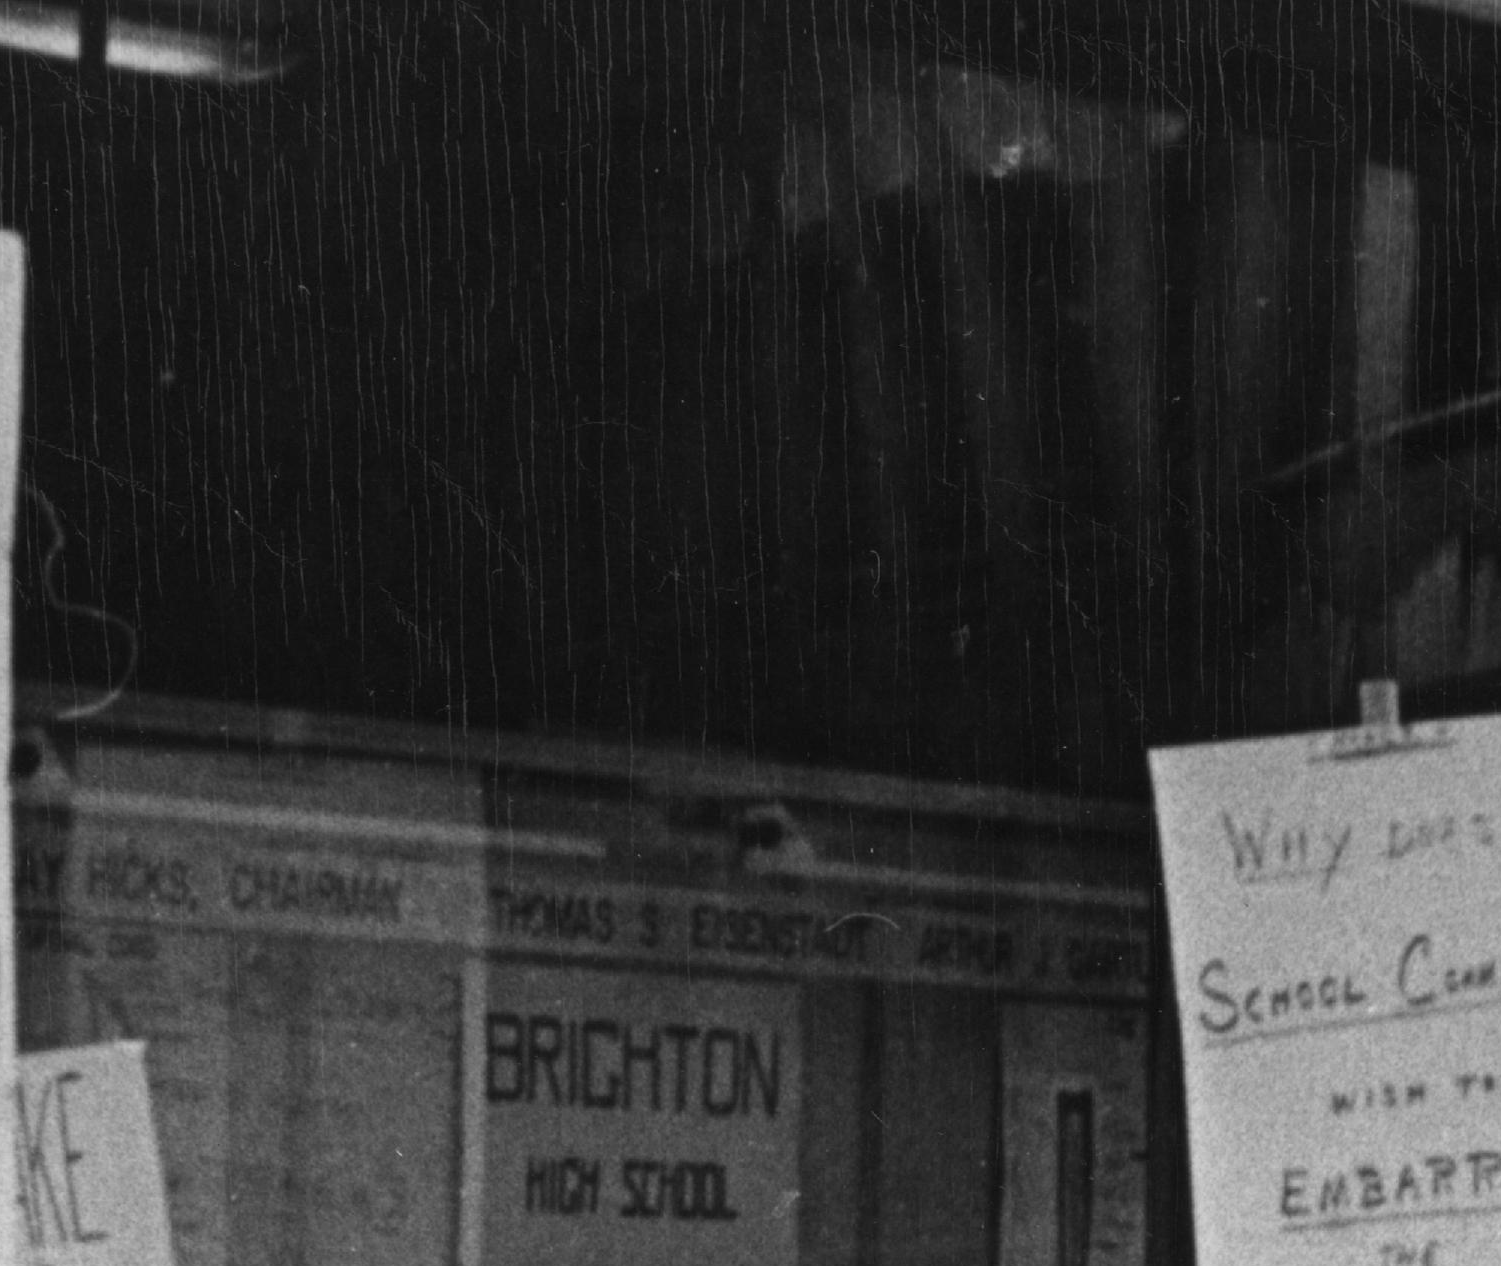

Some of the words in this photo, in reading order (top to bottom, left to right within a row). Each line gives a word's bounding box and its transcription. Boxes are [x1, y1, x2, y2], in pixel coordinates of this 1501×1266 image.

[1200, 958, 1367, 1034] SCHOOL
[485, 1013, 780, 1119] BRIGHTON
[17, 1070, 110, 1247] KE
[526, 1158, 598, 1217] HIGH
[619, 1159, 739, 1220] SCHOOL
